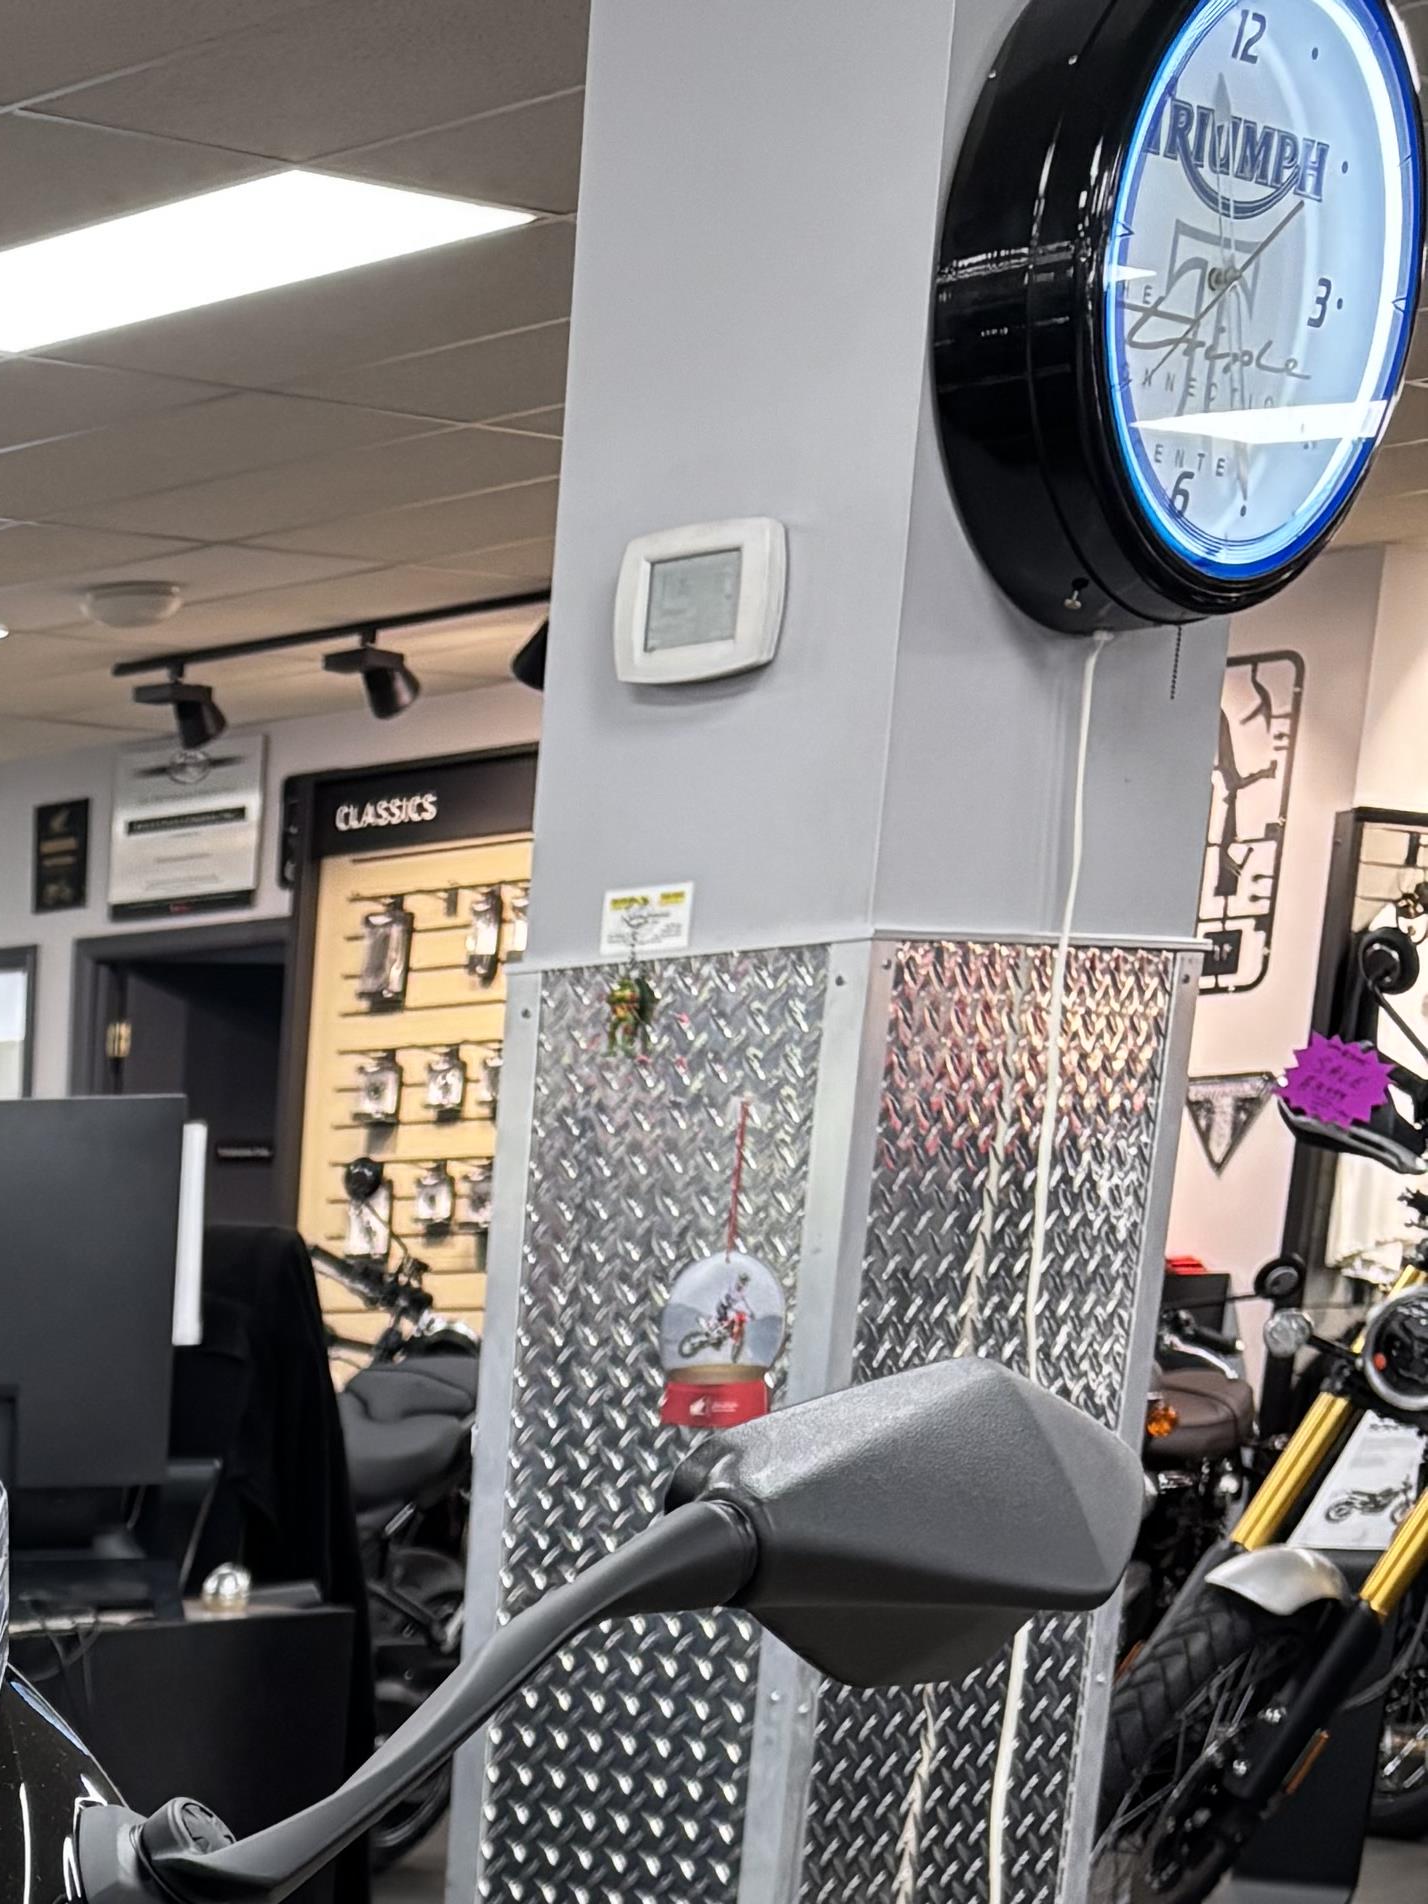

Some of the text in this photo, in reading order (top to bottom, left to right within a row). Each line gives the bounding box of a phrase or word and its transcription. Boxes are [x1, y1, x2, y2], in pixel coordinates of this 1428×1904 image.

[1230, 9, 1267, 64] 12
[1144, 78, 1331, 203] TRIUMPH
[1307, 277, 1332, 328] 3
[1170, 471, 1195, 518] 6
[335, 792, 439, 832] CLASSICS
